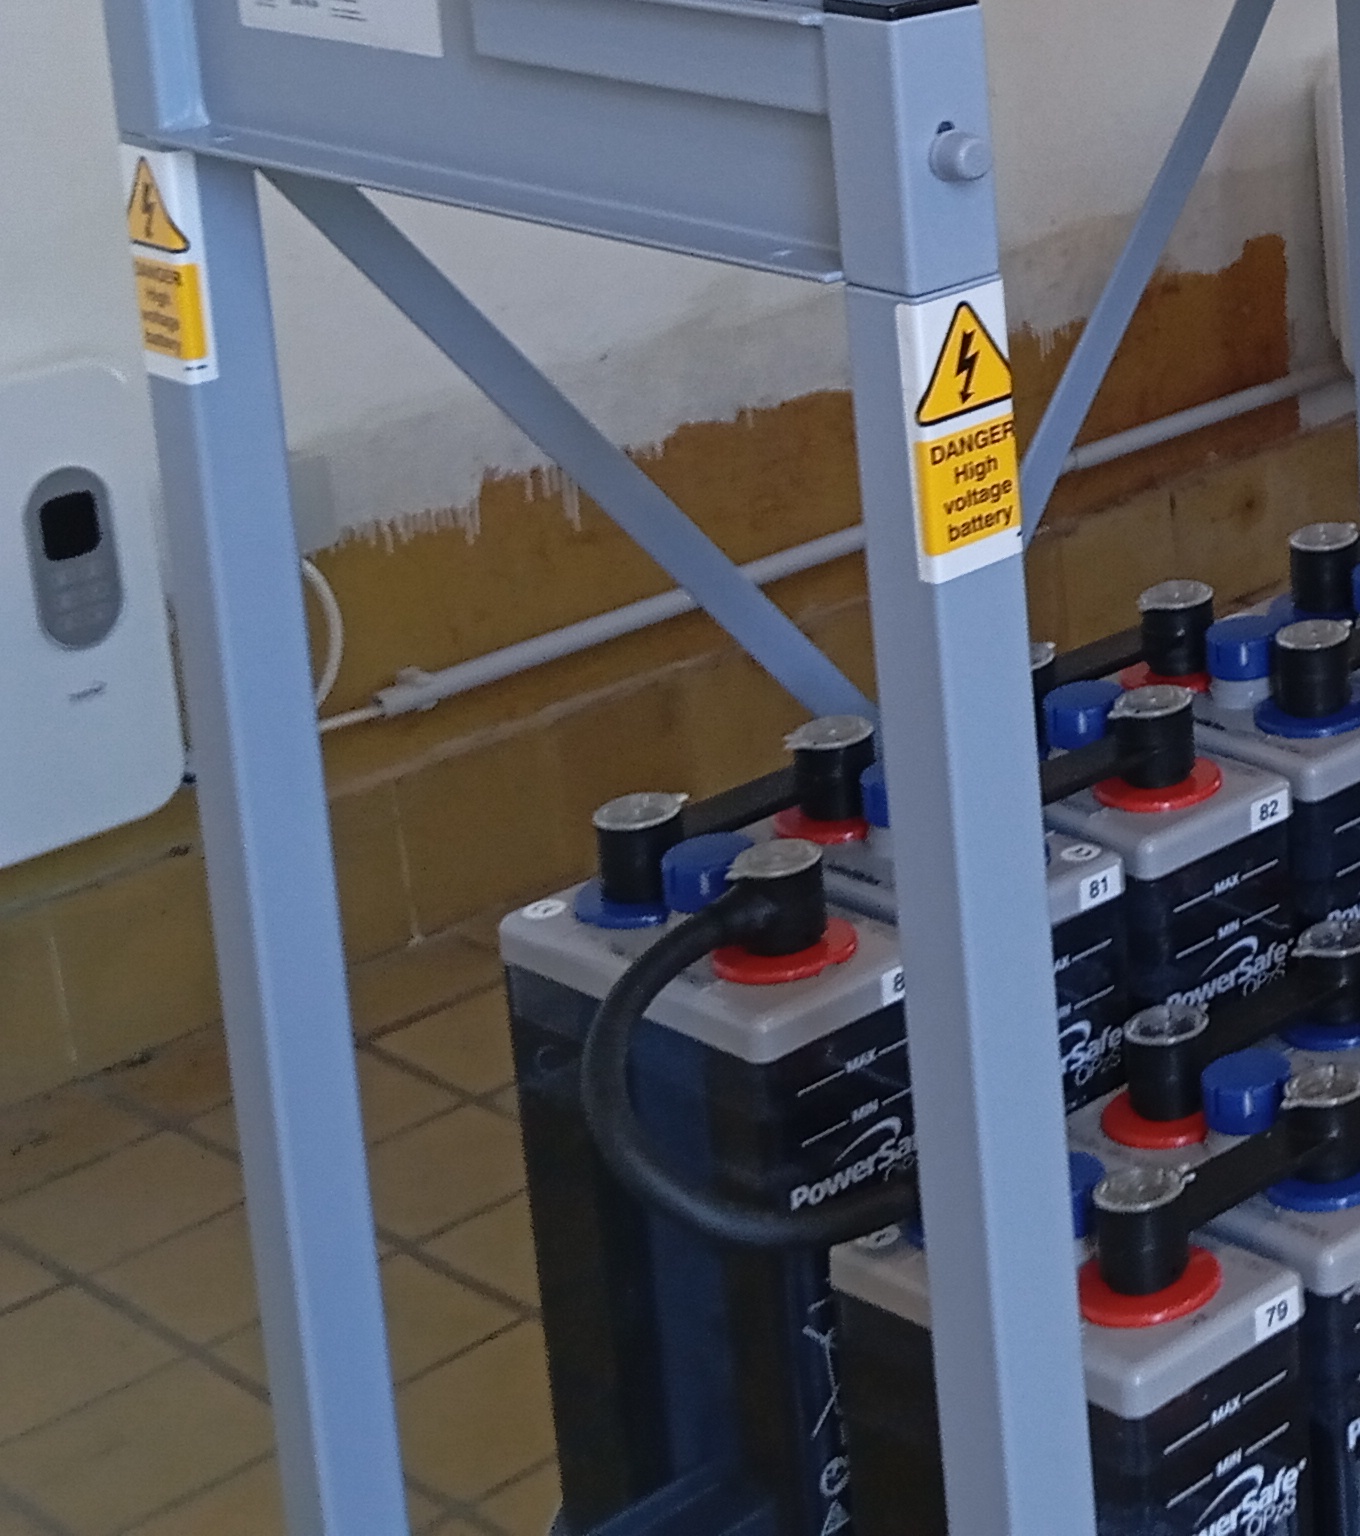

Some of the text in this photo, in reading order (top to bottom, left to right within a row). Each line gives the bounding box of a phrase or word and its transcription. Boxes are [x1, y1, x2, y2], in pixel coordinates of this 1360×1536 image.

[929, 420, 1016, 467] DANGER
[953, 455, 999, 486] High
[943, 477, 1013, 516] voltage
[947, 503, 1014, 544] battery
[1259, 799, 1280, 822] 82
[1088, 875, 1109, 900] 81
[1212, 871, 1242, 896] MAX
[1217, 917, 1241, 940] MIN
[844, 1046, 878, 1074] MAX
[850, 1097, 880, 1125] MIN
[1264, 1300, 1289, 1328] 79
[1209, 1392, 1242, 1428] MAX
[1215, 1446, 1243, 1478] MIN
